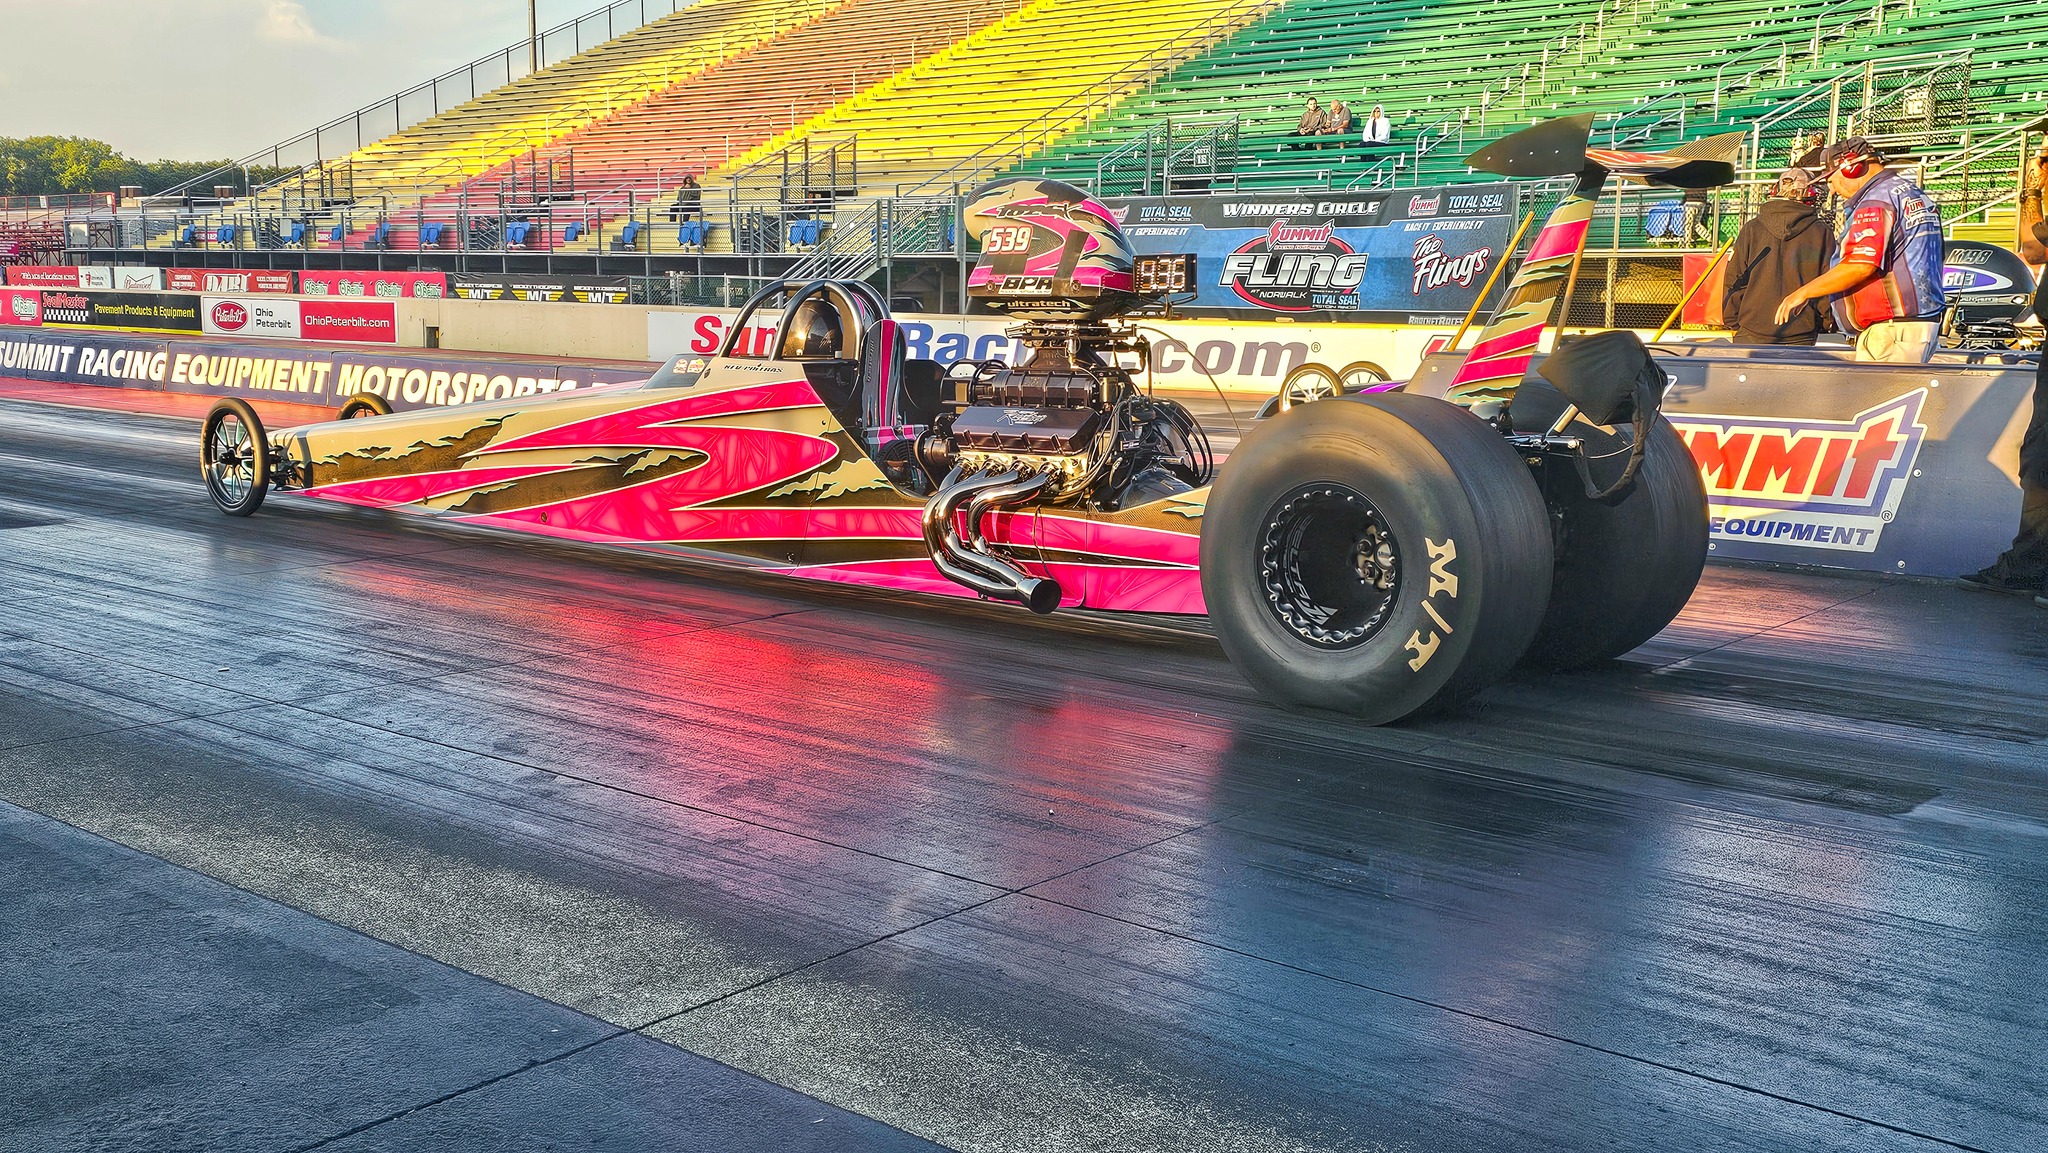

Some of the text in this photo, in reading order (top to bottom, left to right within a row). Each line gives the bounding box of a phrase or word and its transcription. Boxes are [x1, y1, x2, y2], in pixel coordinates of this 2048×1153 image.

[1449, 194, 1504, 208] TOTAL SEAL
[1140, 206, 1192, 217] TOTAL SEAL
[1222, 202, 1380, 217] WINNERS CIRCLE
[1135, 228, 1179, 236] EXPERIENCE
[1404, 222, 1423, 232] RACE
[1432, 221, 1475, 231] EXPERIENCE
[987, 226, 1033, 254] 539
[1412, 234, 1441, 259] The
[1218, 253, 1369, 288] FLING
[1413, 249, 1490, 295] Flings
[1002, 276, 1054, 290] BPA
[1944, 272, 1975, 287] 603
[43, 291, 88, 310] SealMaster
[468, 289, 492, 300] M/T
[526, 290, 551, 302] M/T
[587, 292, 616, 304] M/T
[1259, 291, 1307, 299] NORWALK
[1312, 294, 1358, 306] TOTAL SEAL
[94, 303, 195, 319] Pavement Products & Equipment
[256, 308, 273, 317] Ohio
[256, 319, 291, 329] Peterbilt
[305, 315, 390, 328] OhioPeterbilt.com
[0, 340, 75, 373] SUMMIT
[77, 347, 167, 382] RACING
[170, 353, 331, 394] EQUIPMENT
[1673, 417, 1898, 499] MMIT
[1710, 516, 1874, 546] EQUIPMENT
[1404, 536, 1459, 673] M/T
